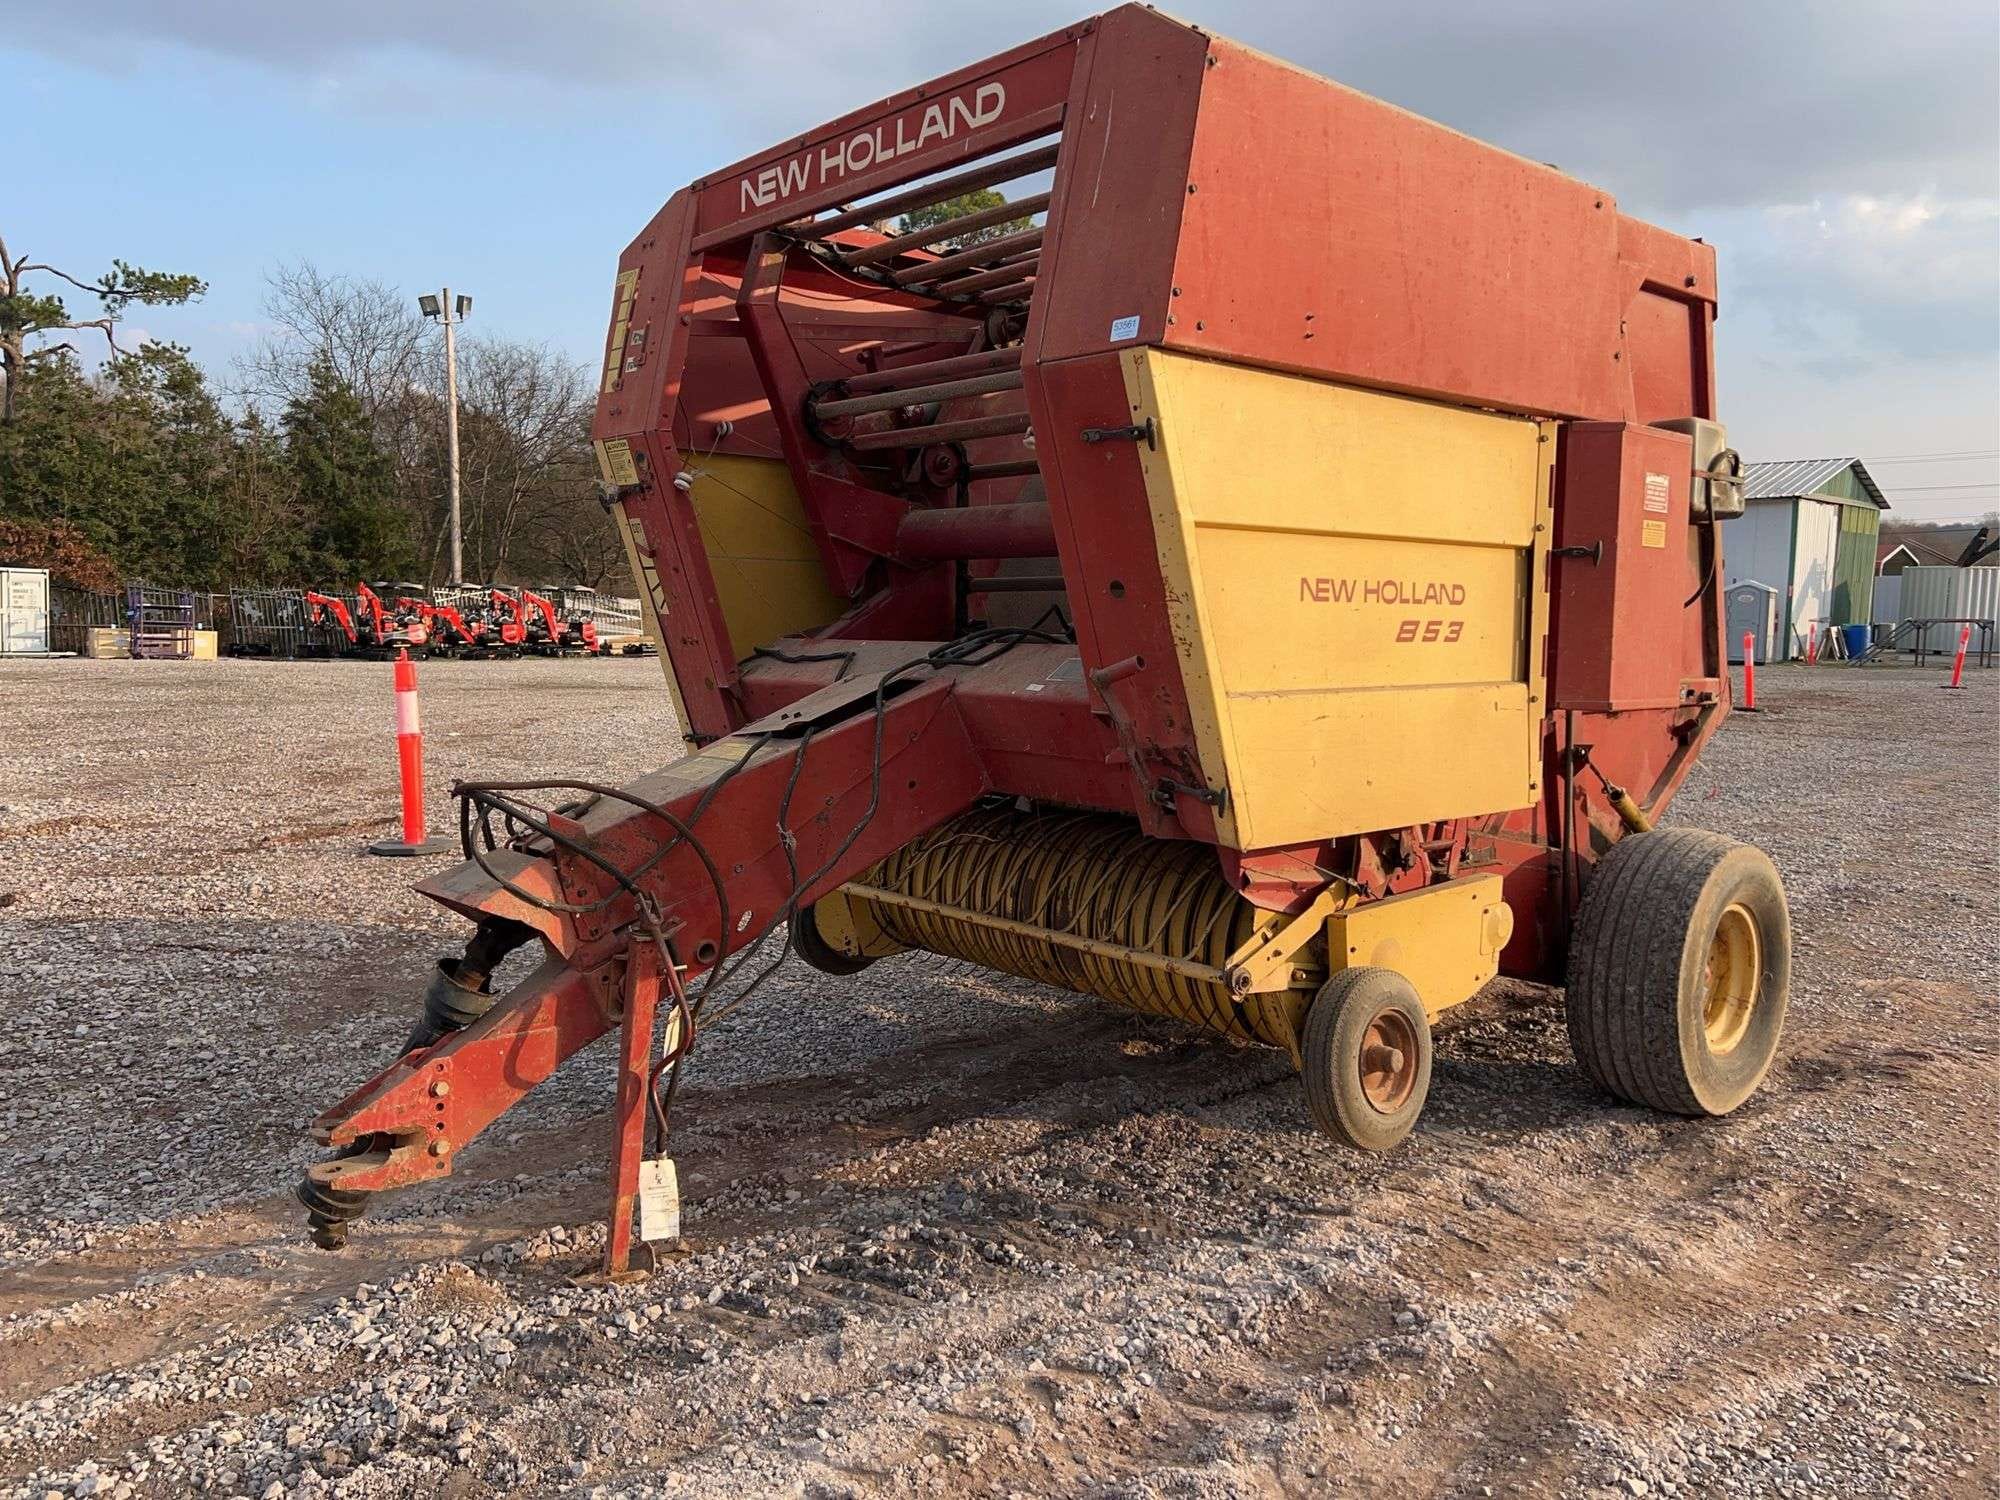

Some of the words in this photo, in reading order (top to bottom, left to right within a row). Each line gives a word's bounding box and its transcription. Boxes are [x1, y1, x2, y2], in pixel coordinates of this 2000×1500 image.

[741, 154, 812, 212] NEW
[820, 82, 1006, 183] HOLLAND
[1300, 577, 1357, 602] NEW
[1364, 580, 1466, 605] HOLLAND
[1395, 620, 1465, 642] 853
